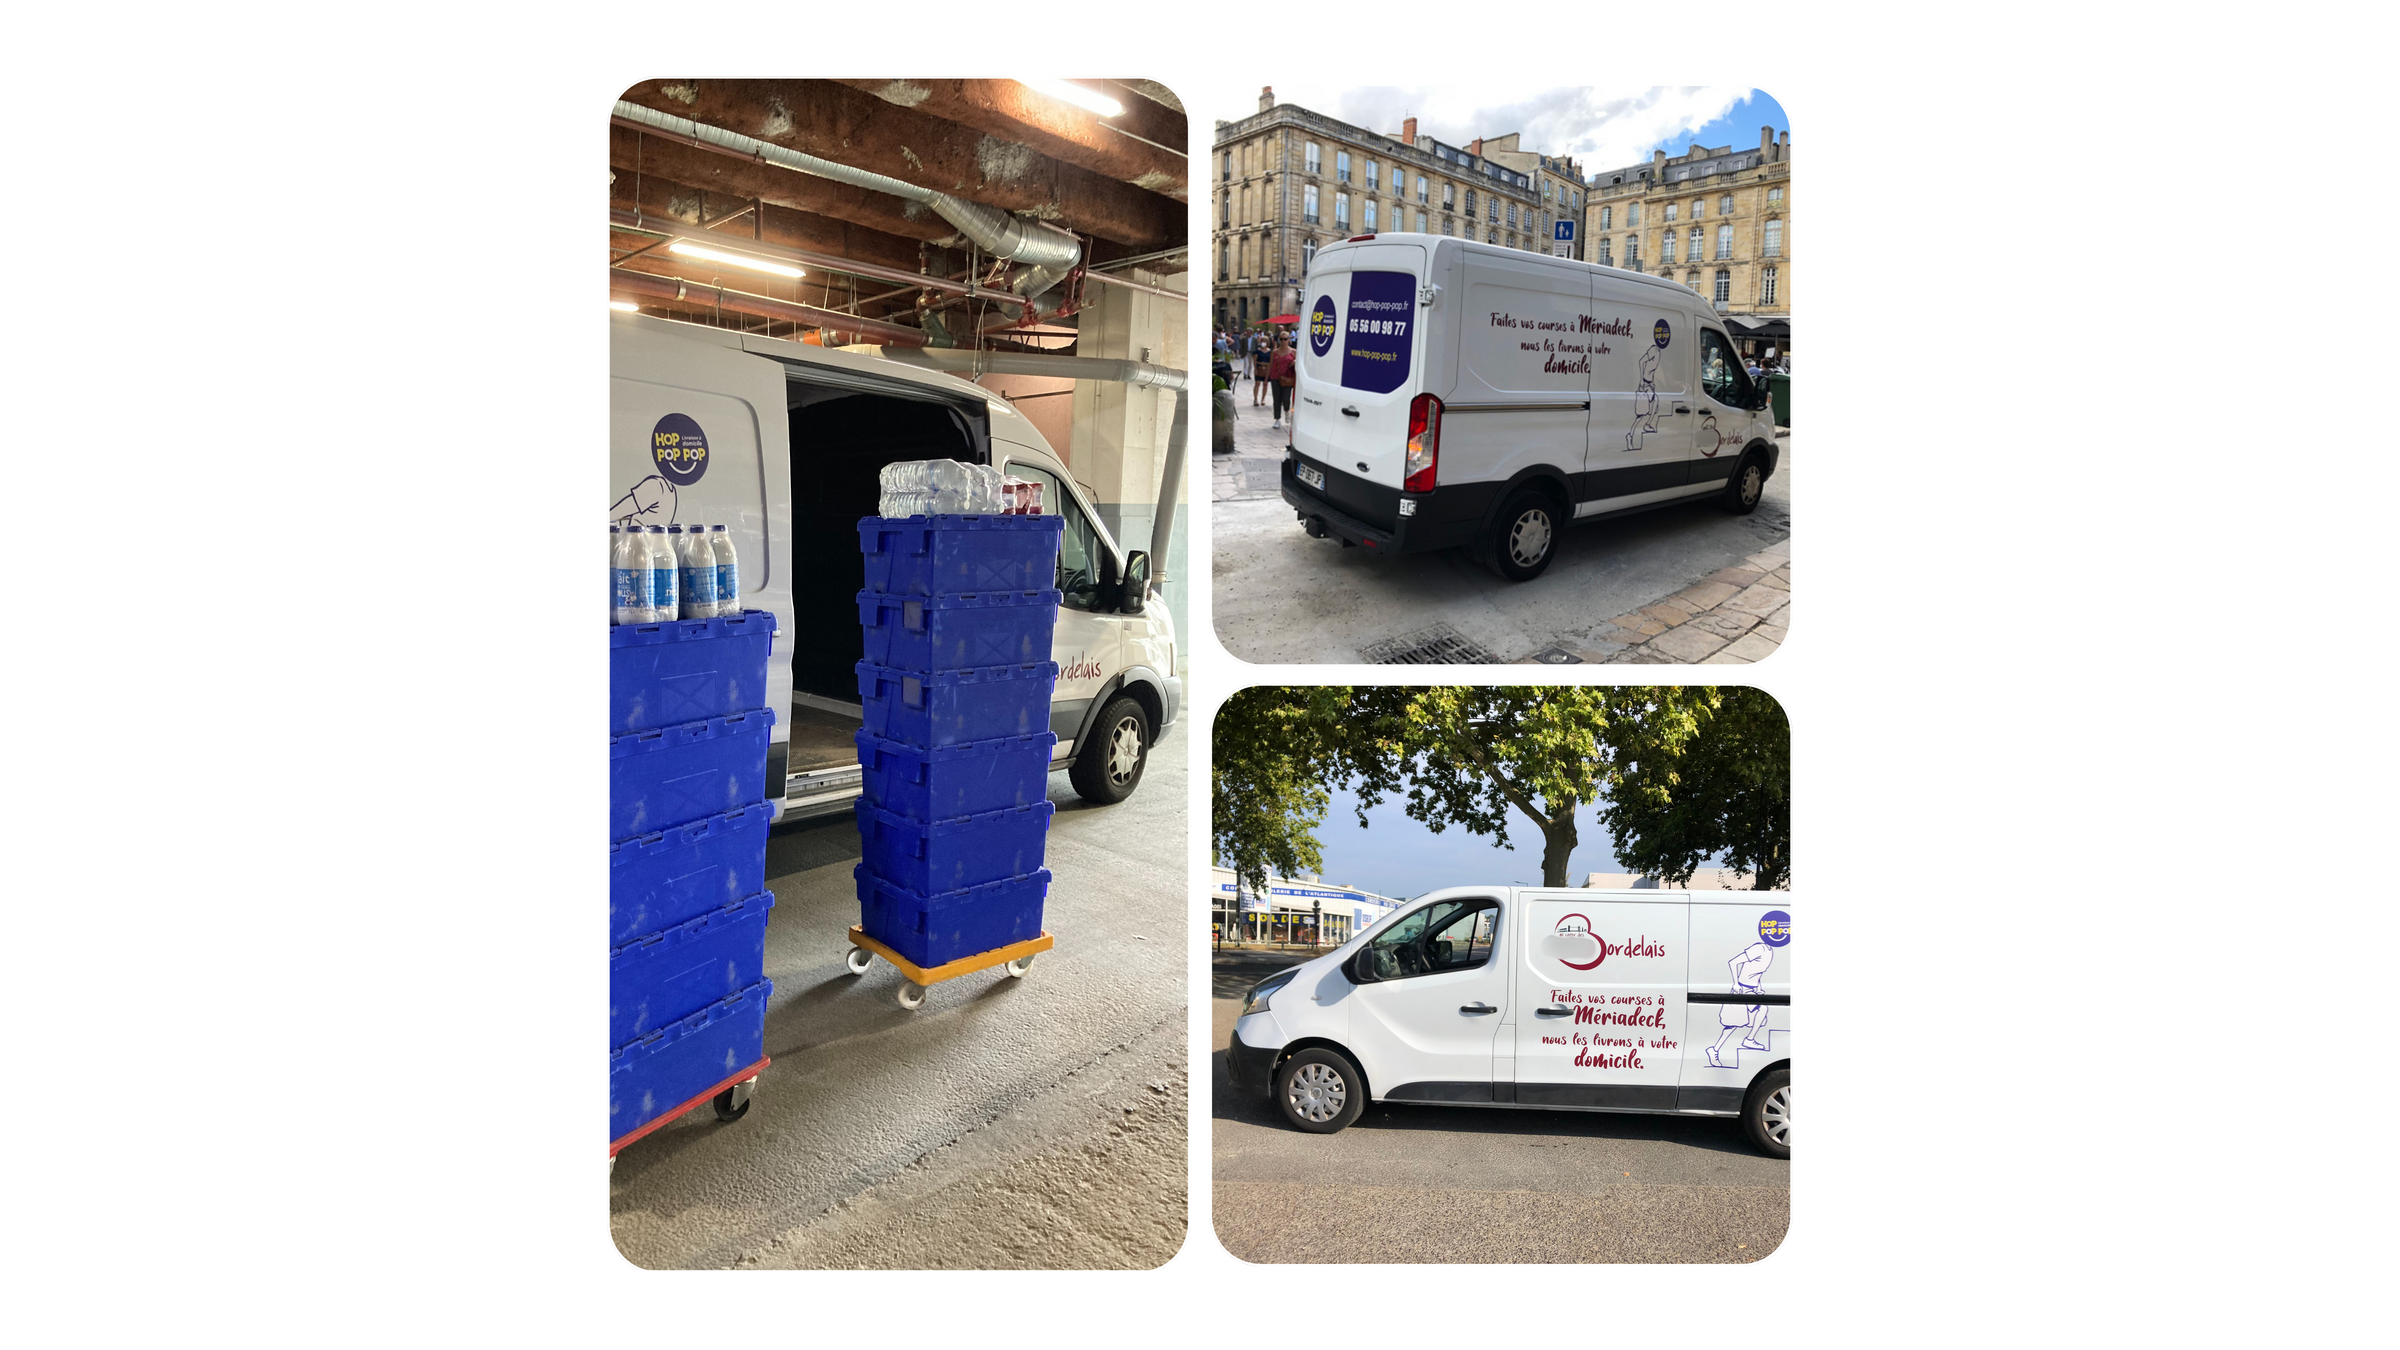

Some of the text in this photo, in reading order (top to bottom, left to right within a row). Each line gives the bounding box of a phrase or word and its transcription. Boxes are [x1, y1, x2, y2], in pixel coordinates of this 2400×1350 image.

[1312, 311, 1324, 323] HOP
[1490, 312, 1634, 339] Faites vos courses à Mériadeck,
[1311, 324, 1335, 337] POP POP
[1349, 318, 1359, 332] 05
[1359, 319, 1370, 333] 56
[1370, 320, 1381, 334] 00
[1381, 320, 1393, 335] 98
[1394, 321, 1407, 336] 77
[1520, 341, 1540, 352] nous
[1543, 338, 1555, 352] les
[1558, 339, 1585, 354] livrons
[1594, 341, 1611, 355] votre
[1351, 348, 1398, 363] www.hop-pop-pop.fr
[1544, 352, 1590, 375] domicile.
[655, 432, 680, 446] HOP
[657, 447, 706, 462] POP POP
[1760, 920, 1777, 928] HOP
[1761, 927, 1777, 936] POP
[1551, 989, 1665, 1006] Faites vos courses à
[1573, 1004, 1666, 1030] Mériadeck,
[1542, 1031, 1678, 1050] nous les livrons à votre
[1574, 1046, 1645, 1070] domicile.
